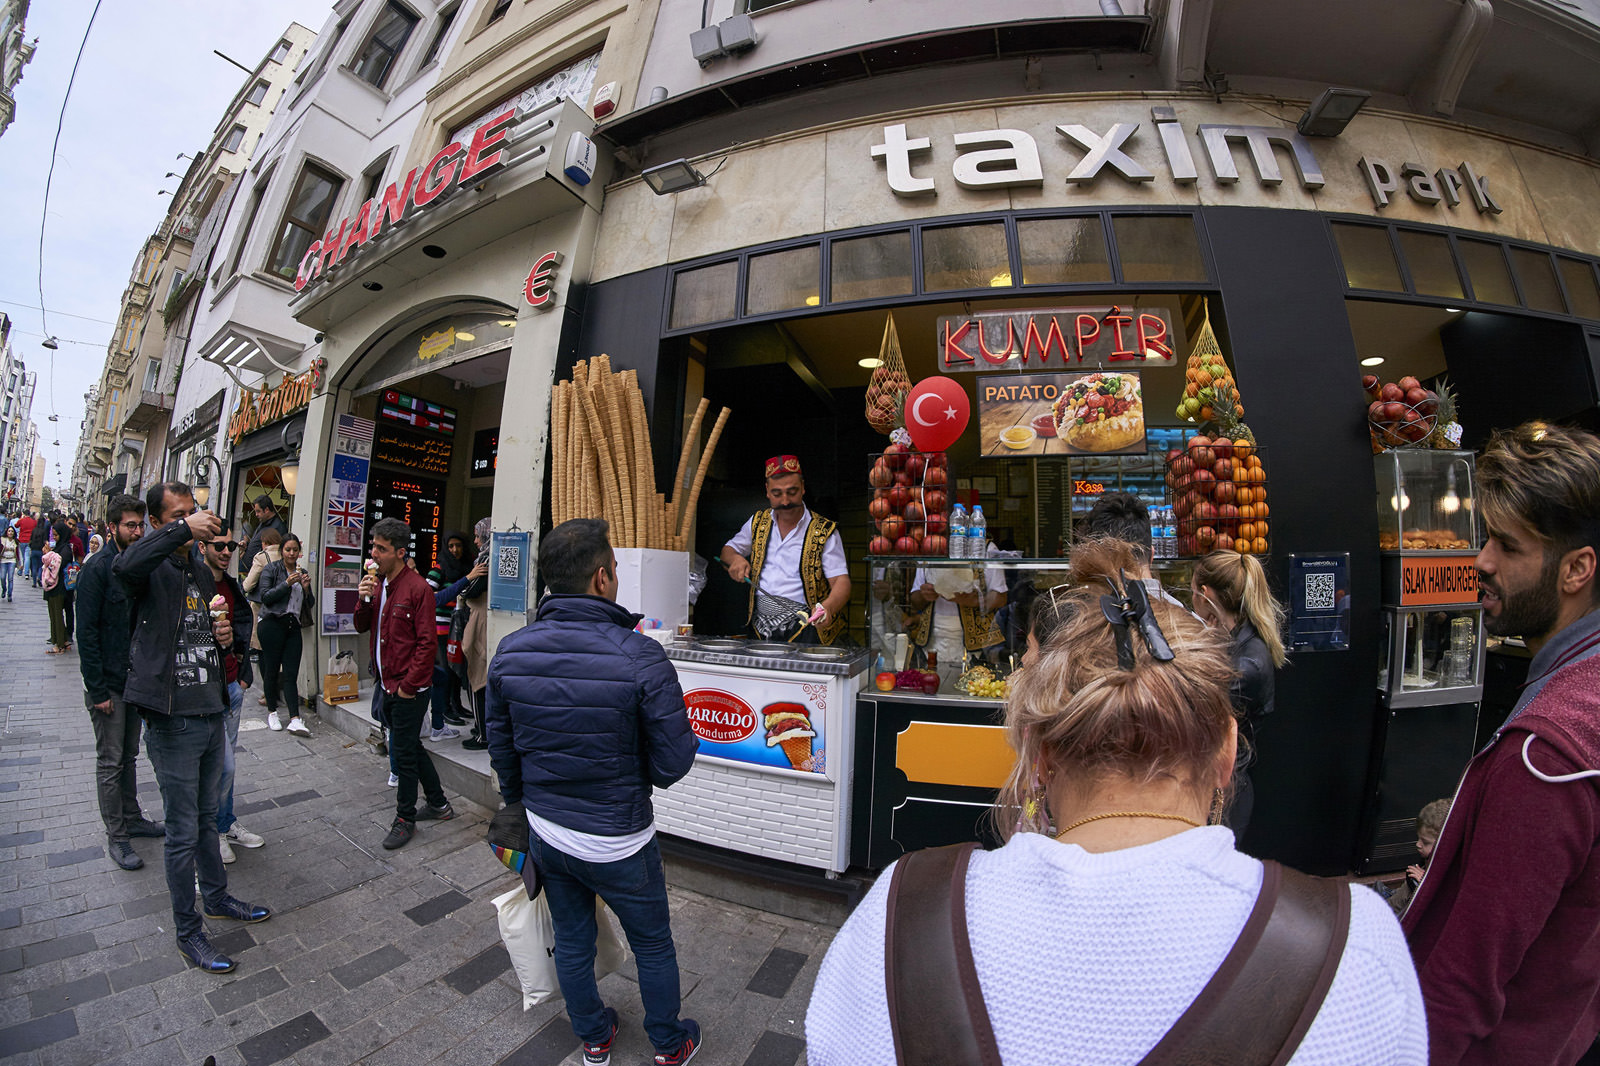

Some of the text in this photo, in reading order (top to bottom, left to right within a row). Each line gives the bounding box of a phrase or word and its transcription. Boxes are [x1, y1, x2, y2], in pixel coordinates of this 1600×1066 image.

[871, 106, 1503, 215] taxim park
[293, 106, 520, 293] CHANGE
[985, 384, 1058, 401] PATATO
[175, 408, 198, 438] DIESEL
[1074, 480, 1105, 494] Kasa
[1403, 567, 1427, 594] ISLAK
[691, 721, 743, 739] Dondurma
